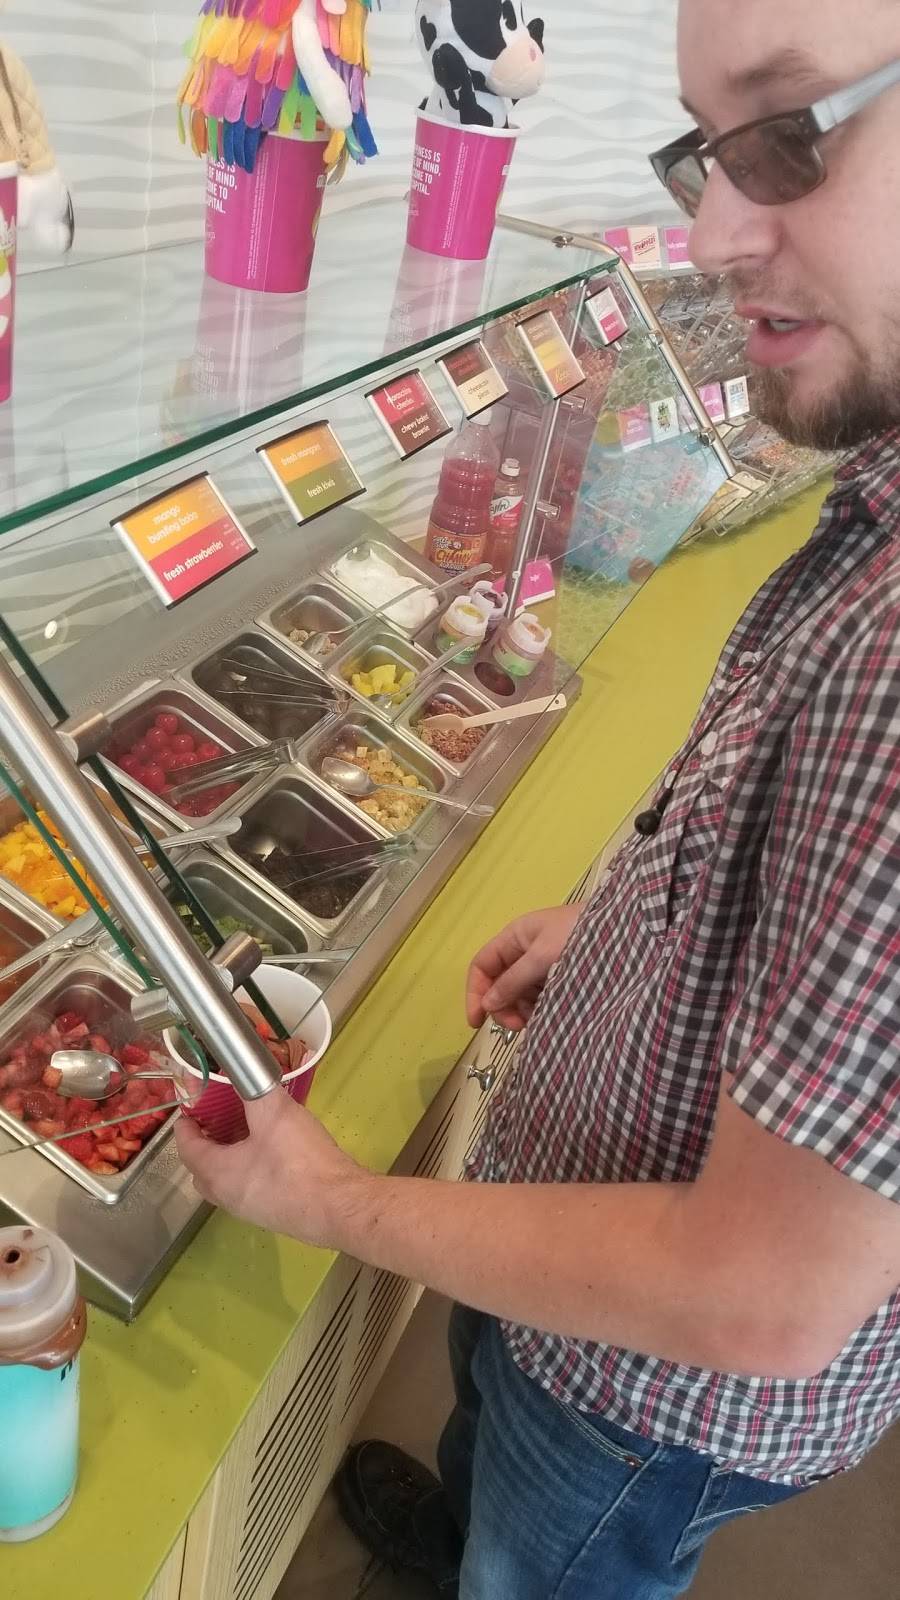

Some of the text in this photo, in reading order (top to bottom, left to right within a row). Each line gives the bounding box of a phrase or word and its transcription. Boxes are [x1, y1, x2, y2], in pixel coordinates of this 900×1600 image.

[215, 169, 238, 190] MIND,
[219, 184, 228, 200] TO
[306, 486, 322, 498] fresh
[153, 505, 180, 525] mango
[163, 540, 224, 582] fresh strawberries
